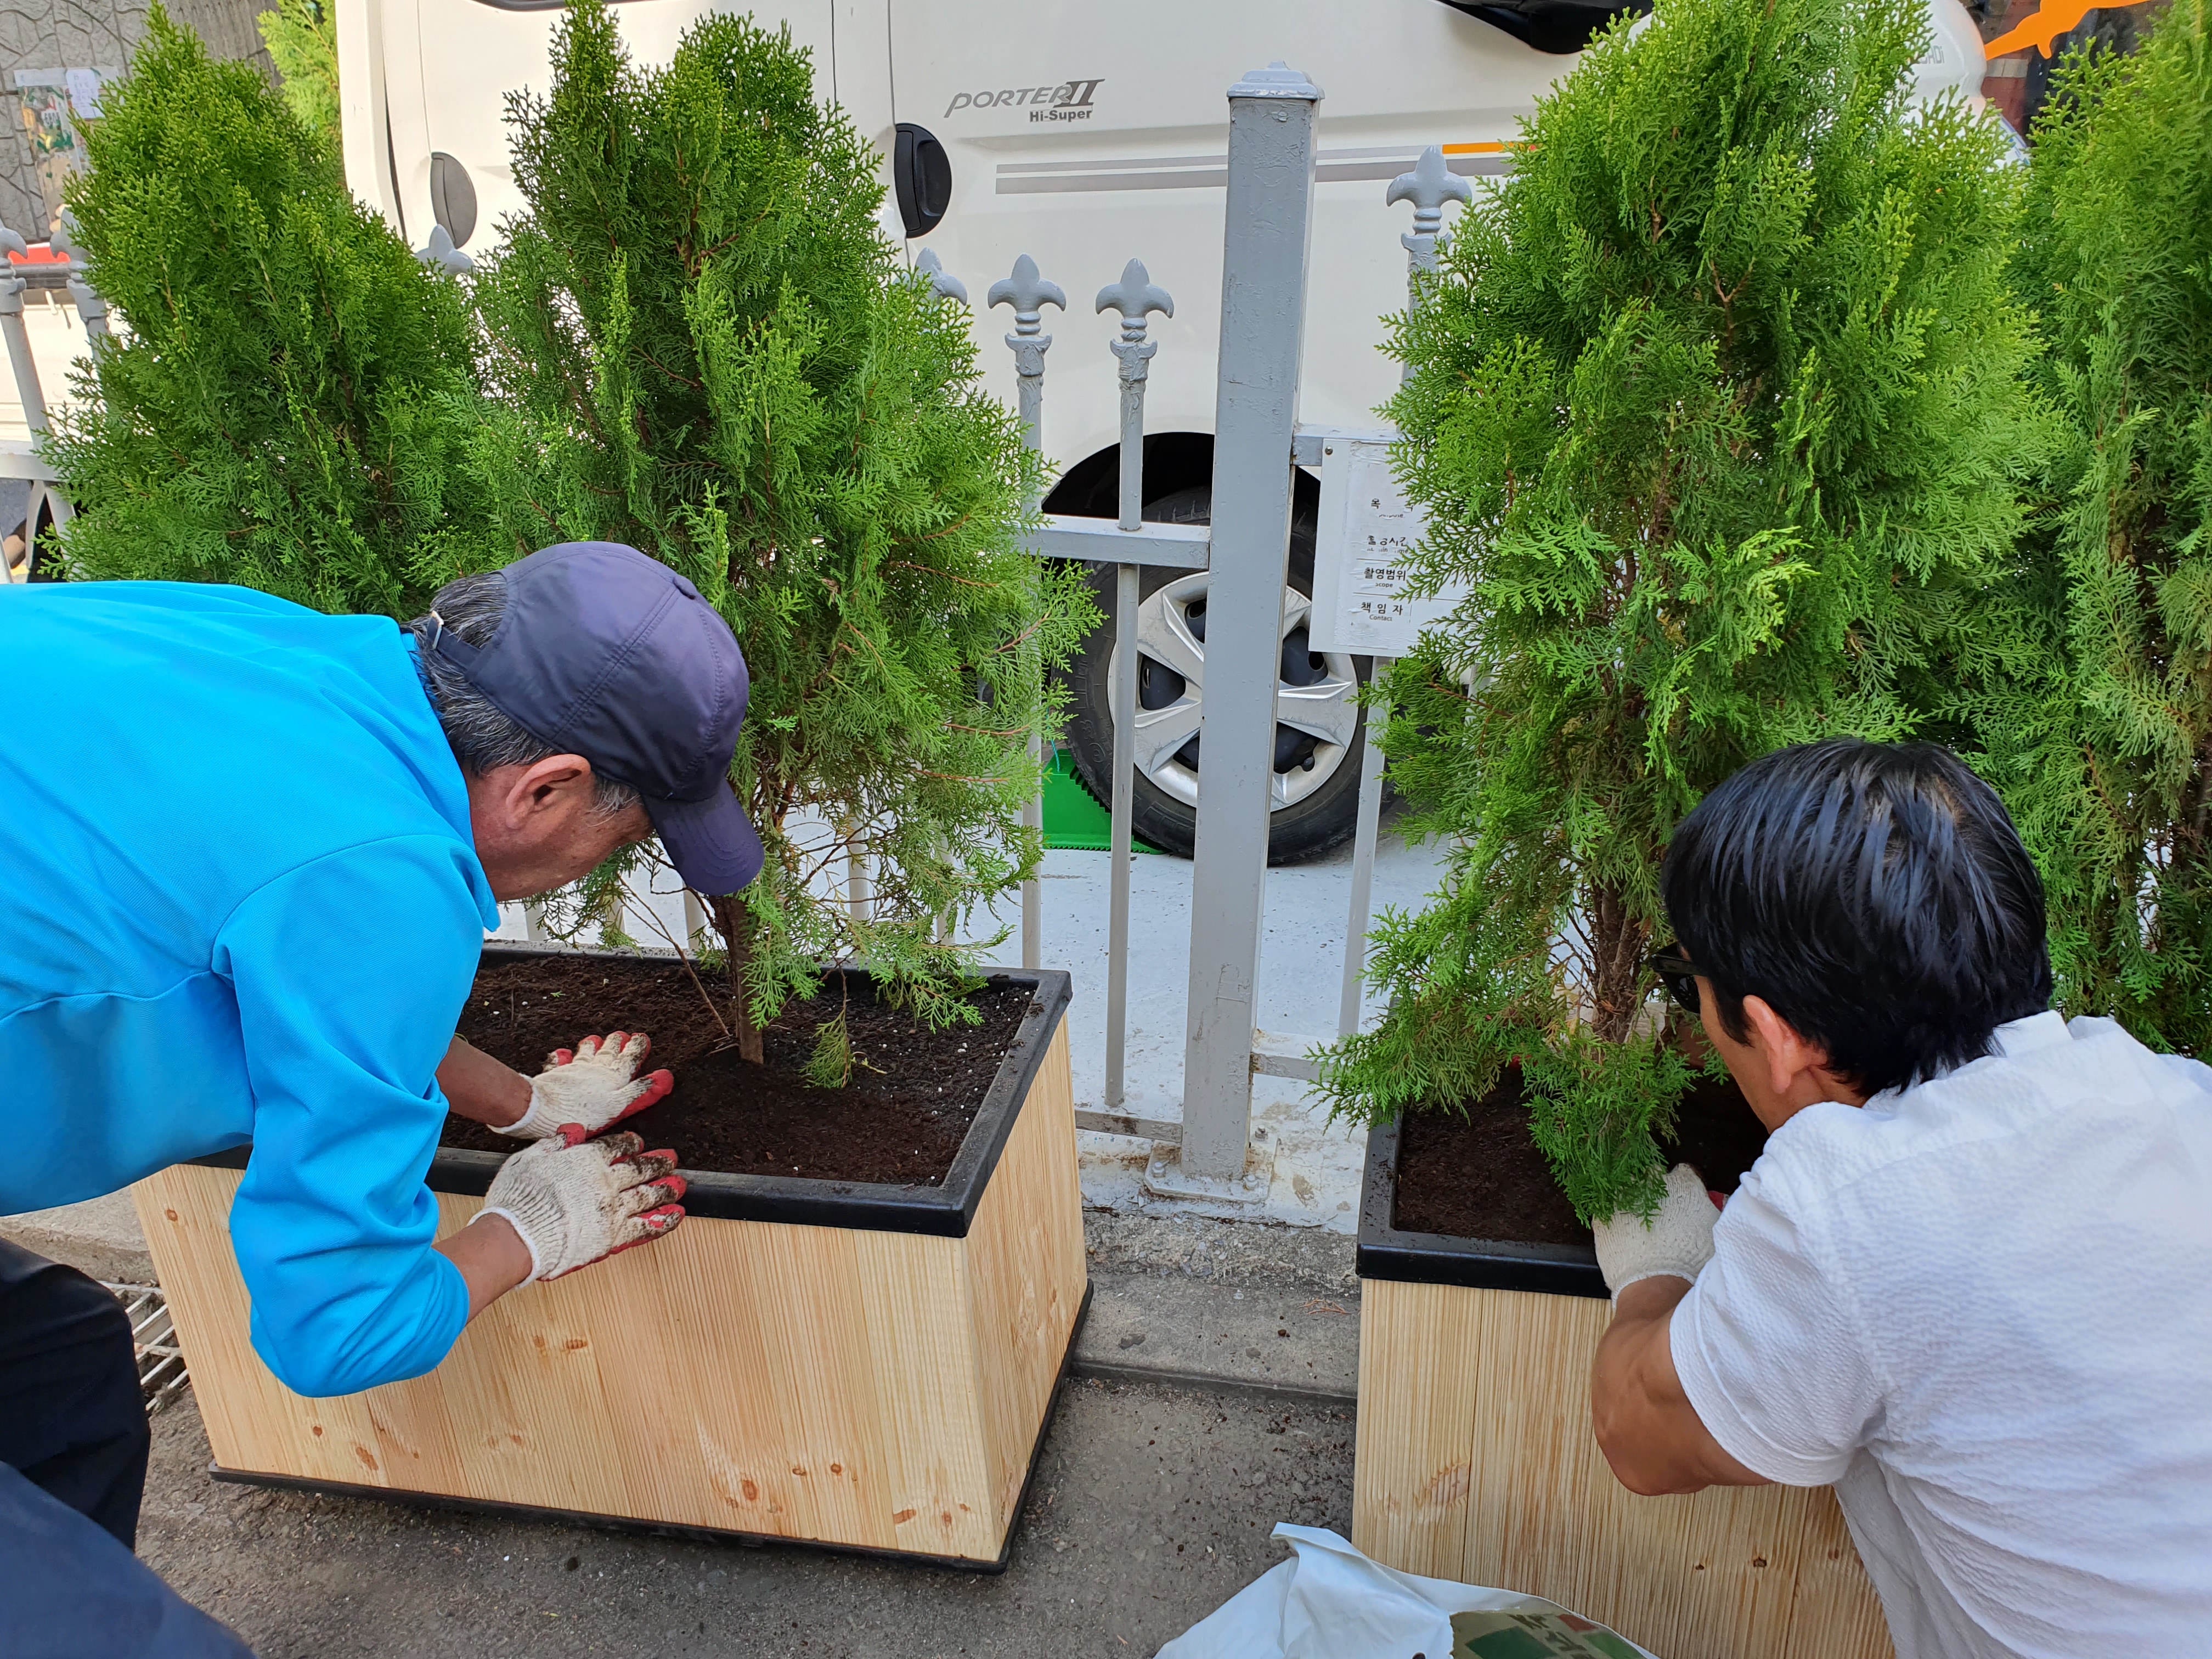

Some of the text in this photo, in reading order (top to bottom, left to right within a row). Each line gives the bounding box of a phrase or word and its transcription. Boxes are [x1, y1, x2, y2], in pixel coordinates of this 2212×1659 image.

[944, 84, 1073, 118] PORTER
[1029, 110, 1092, 122] Hi-Super
[1364, 567, 1406, 581] 촬영범위
